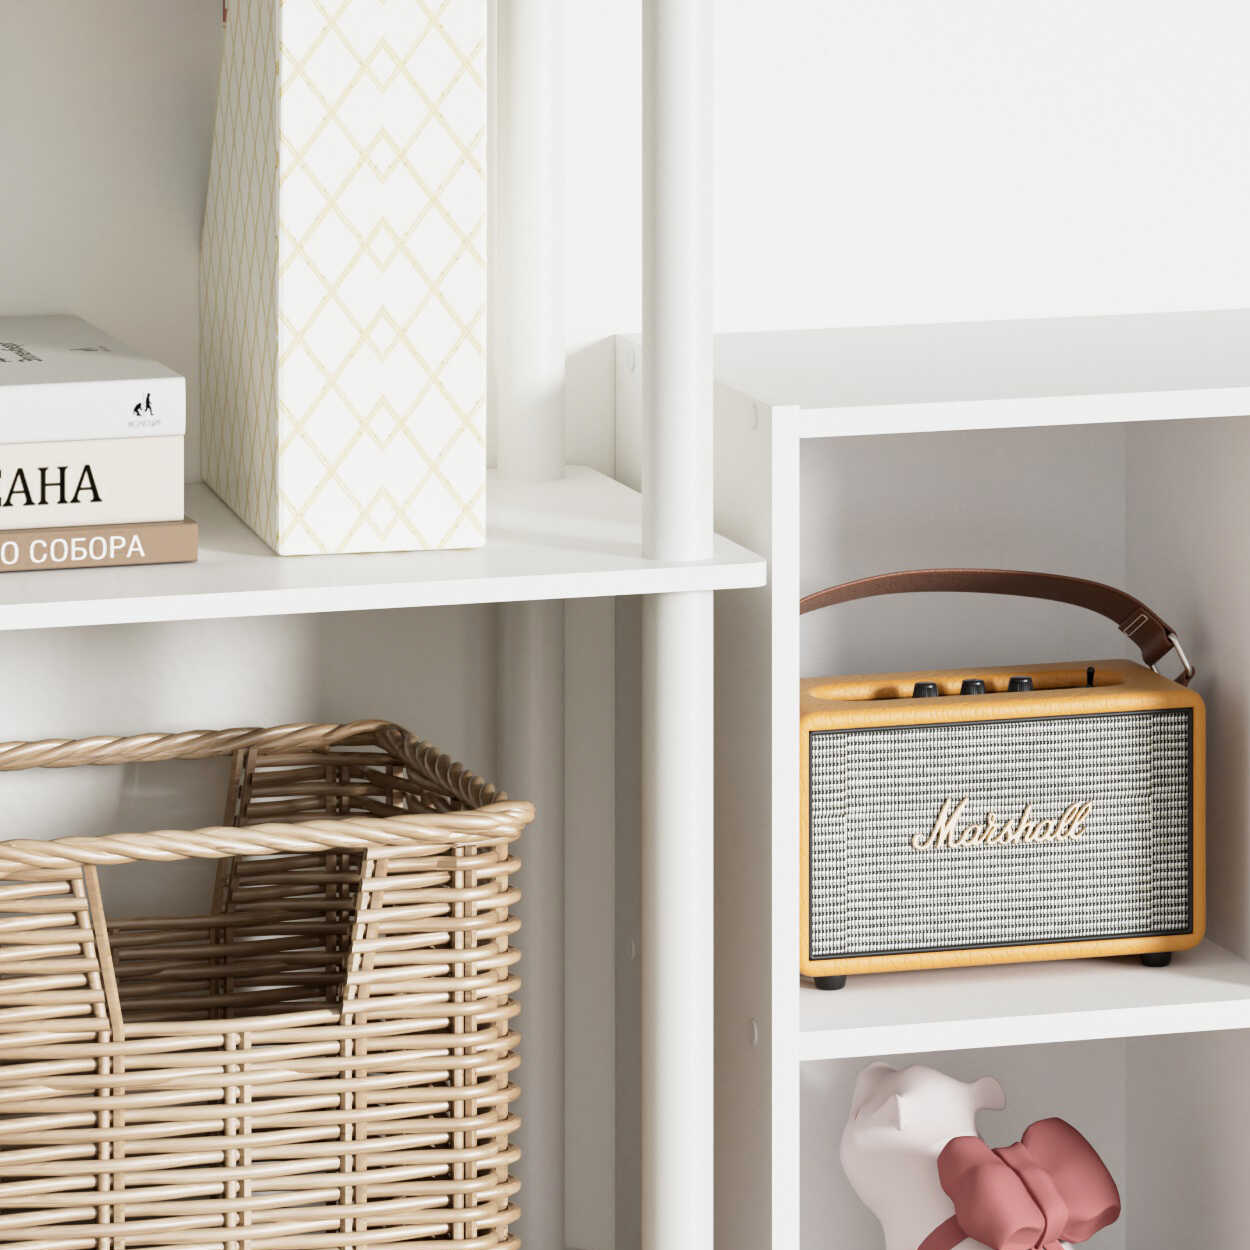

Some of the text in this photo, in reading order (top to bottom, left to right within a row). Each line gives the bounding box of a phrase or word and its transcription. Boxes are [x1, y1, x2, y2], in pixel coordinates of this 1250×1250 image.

[0, 464, 102, 507] АНА
[29, 534, 146, 564] СОБОРА
[911, 793, 1092, 851] Marshall
